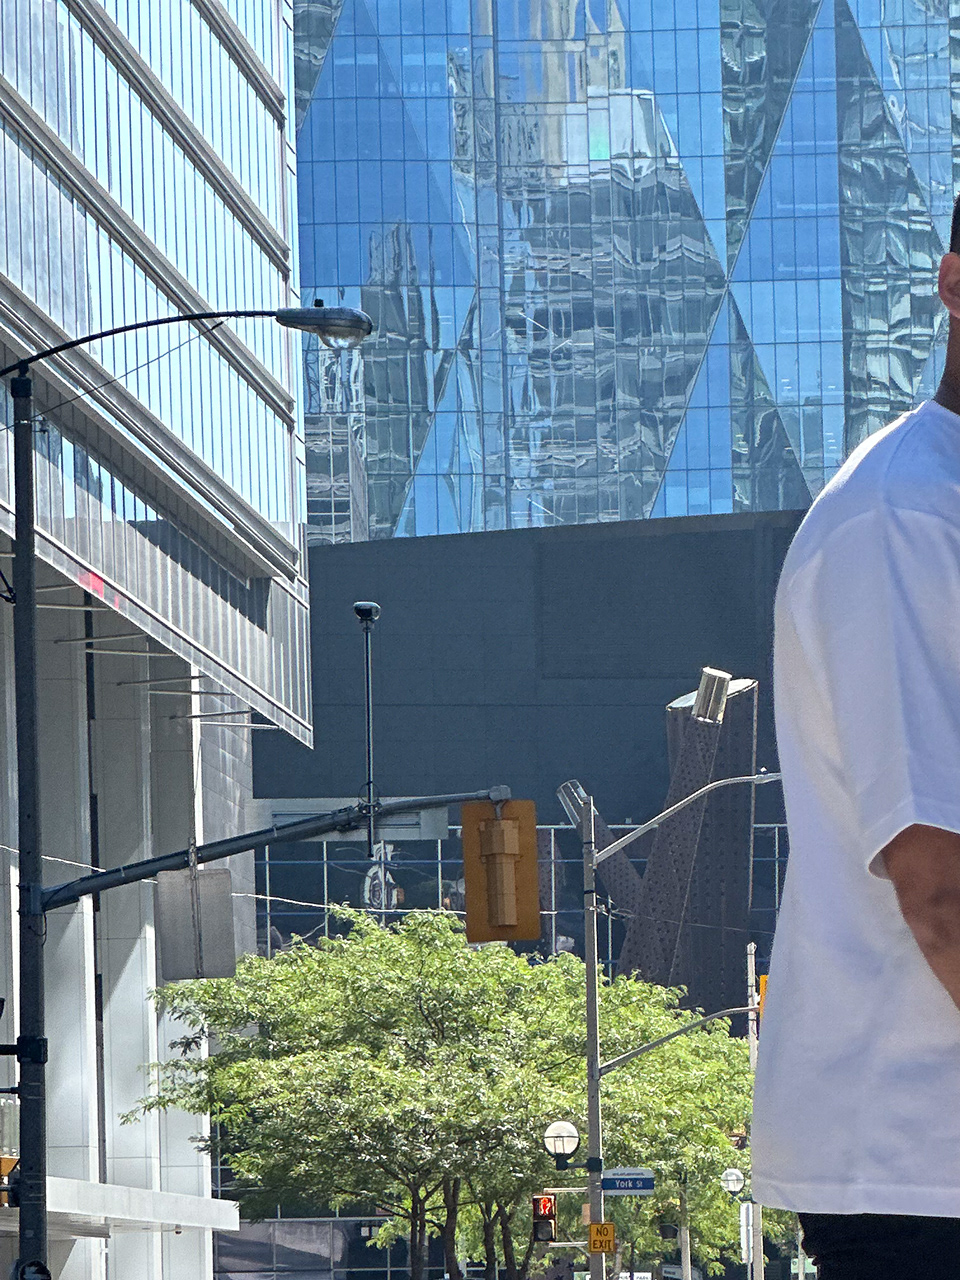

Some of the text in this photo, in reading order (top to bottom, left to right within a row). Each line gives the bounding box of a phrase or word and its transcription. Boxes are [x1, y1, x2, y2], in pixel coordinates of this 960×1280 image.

[615, 1180, 633, 1188] York
[596, 1227, 609, 1236] NO
[592, 1239, 611, 1249] EXIT
